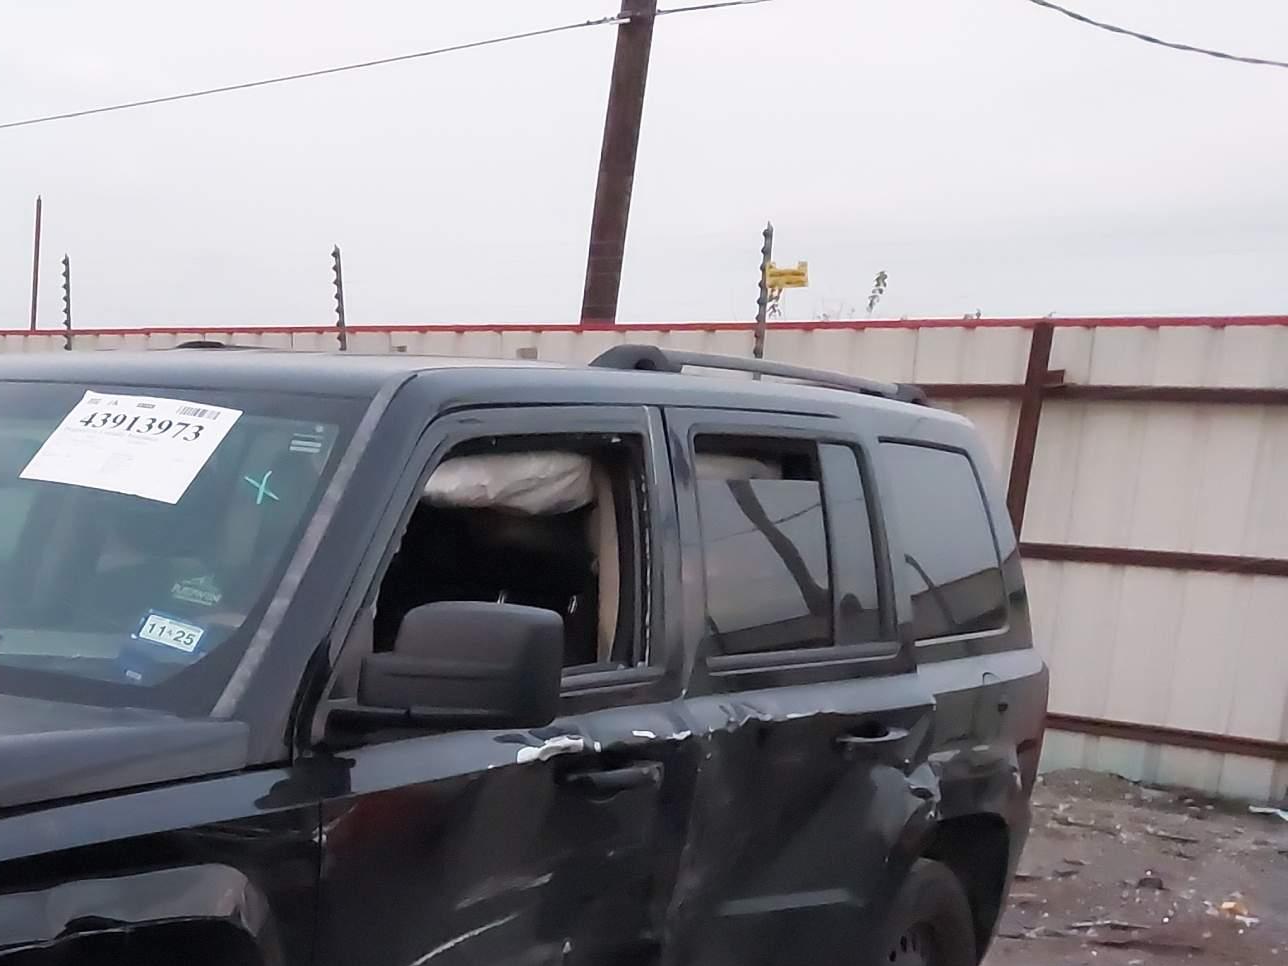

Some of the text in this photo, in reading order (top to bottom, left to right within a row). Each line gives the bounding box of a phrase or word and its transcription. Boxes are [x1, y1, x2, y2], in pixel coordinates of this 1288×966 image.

[79, 411, 205, 442] 43913973
[148, 623, 196, 645] 11 25
